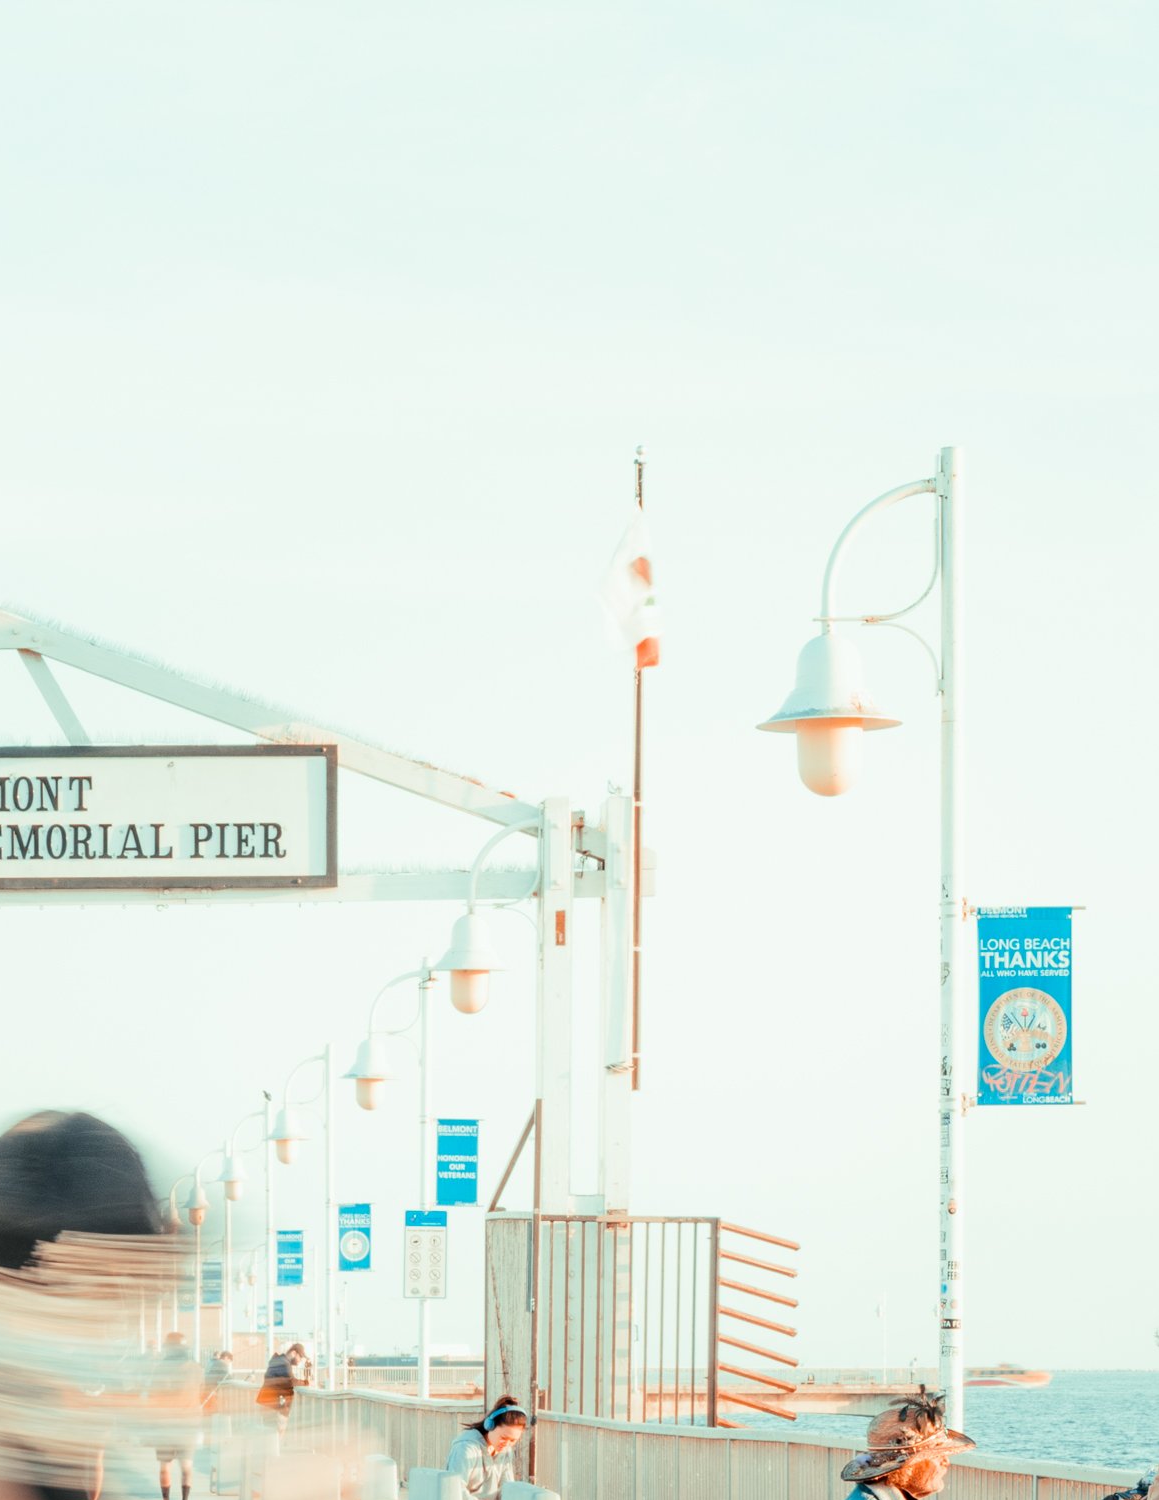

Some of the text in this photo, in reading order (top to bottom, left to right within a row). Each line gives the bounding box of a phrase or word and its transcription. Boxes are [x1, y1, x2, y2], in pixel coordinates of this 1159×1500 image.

[189, 822, 287, 860] PIER
[981, 938, 1071, 951] LONG BEACH
[981, 951, 1071, 969] THANKS
[981, 970, 995, 978] ALL
[1039, 969, 1070, 977] SERVED
[438, 1125, 478, 1133] BELMONT
[438, 1171, 477, 1179] VETERANS
